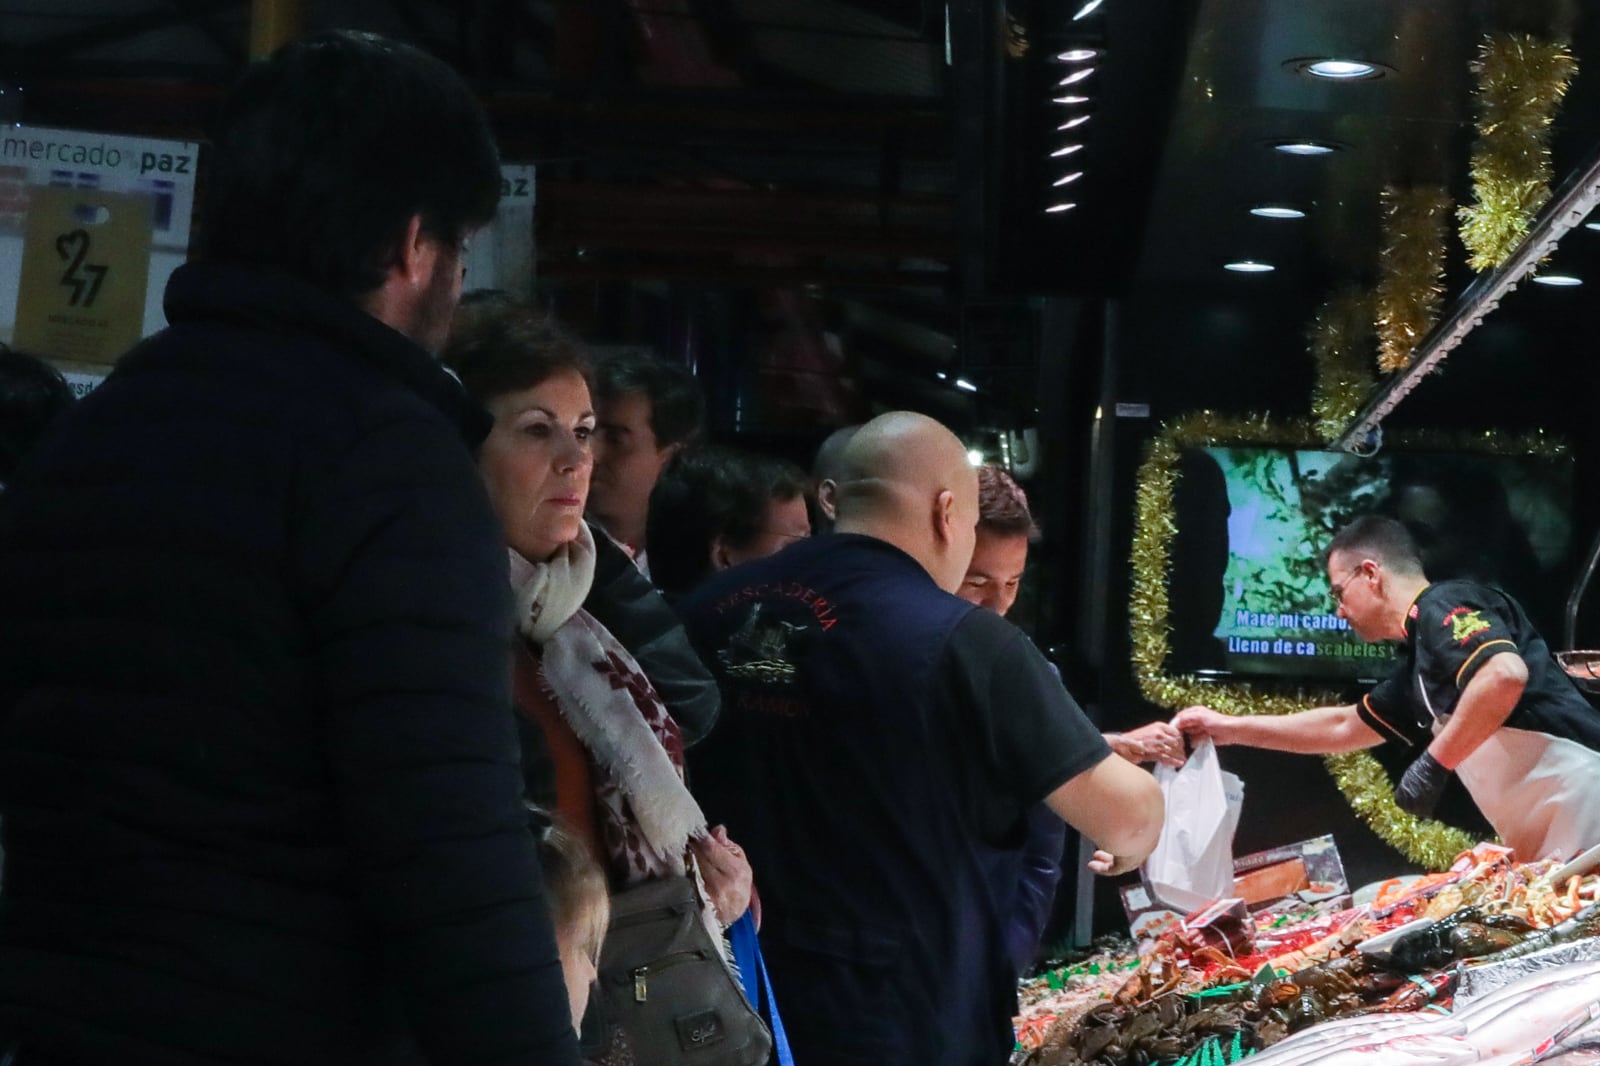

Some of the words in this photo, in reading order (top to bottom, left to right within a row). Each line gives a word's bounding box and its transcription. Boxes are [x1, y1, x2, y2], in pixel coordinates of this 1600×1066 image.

[3, 136, 122, 169] mercado
[139, 151, 192, 175] paz
[1236, 610, 1274, 628] Mare
[1279, 613, 1299, 629] mi
[1302, 613, 1353, 631] carbu
[1228, 637, 1269, 654] Lleno
[1273, 639, 1293, 654] de
[1296, 642, 1386, 658] cascabeles
